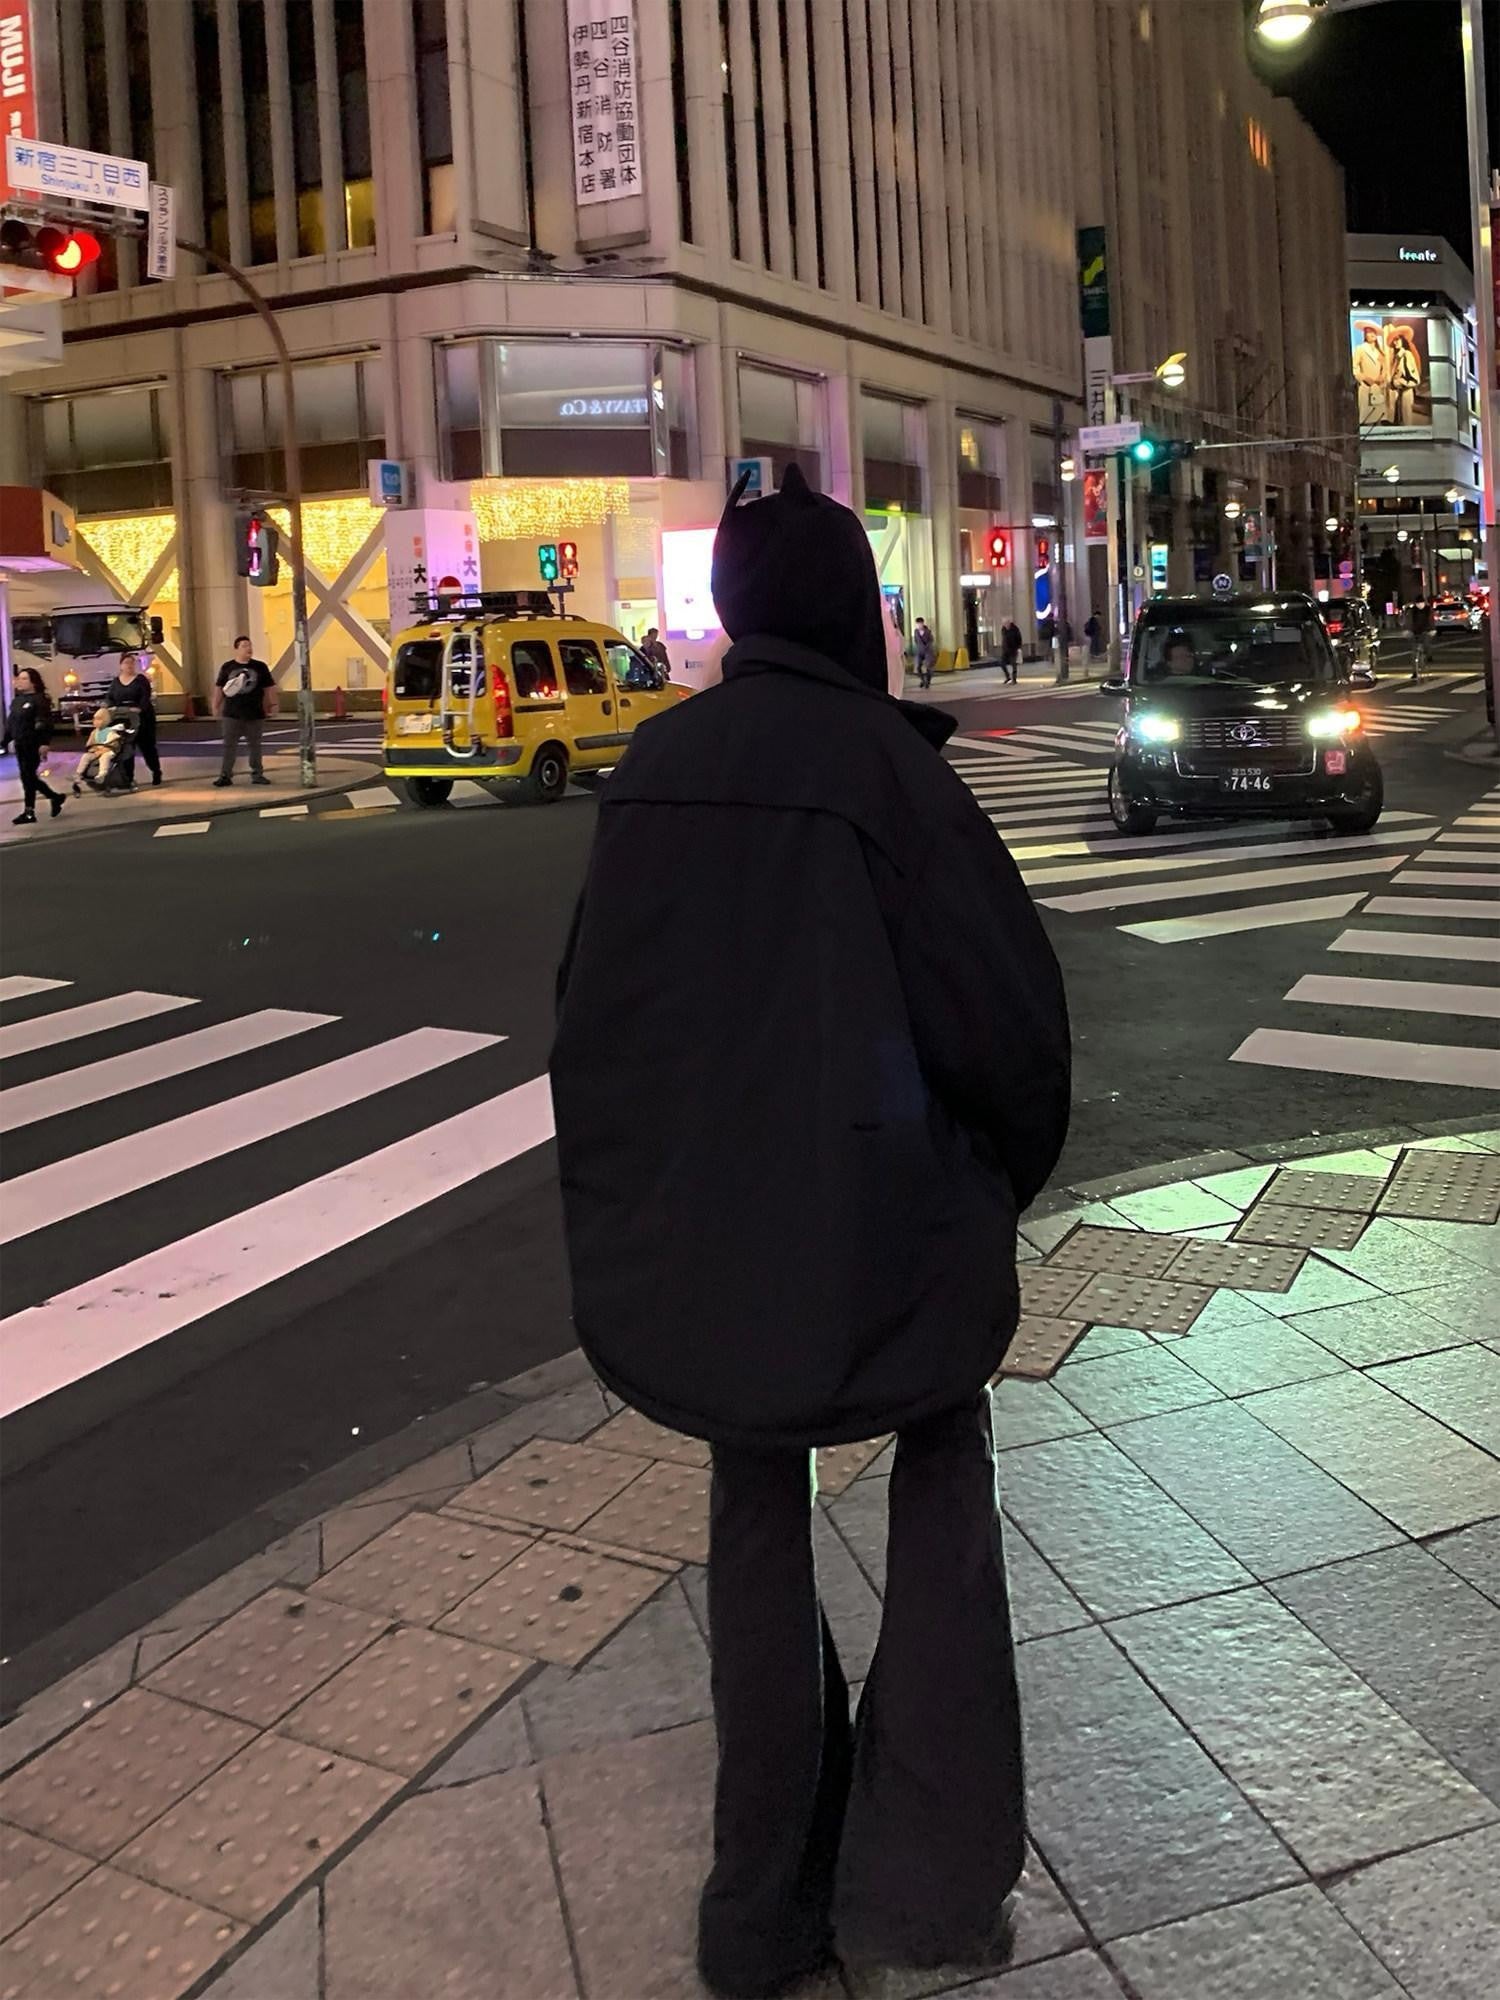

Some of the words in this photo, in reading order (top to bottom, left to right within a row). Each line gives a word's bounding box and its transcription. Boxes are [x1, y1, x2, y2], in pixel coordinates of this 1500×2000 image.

[0, 15, 26, 97] MUJI
[572, 25, 597, 194] 伊勢丹新宿本店
[590, 20, 617, 191] 四谷消防署
[15, 147, 141, 188] 新宿三丁目西
[41, 174, 90, 192] Shinjuku
[1231, 776, 1271, 790] 74-46
